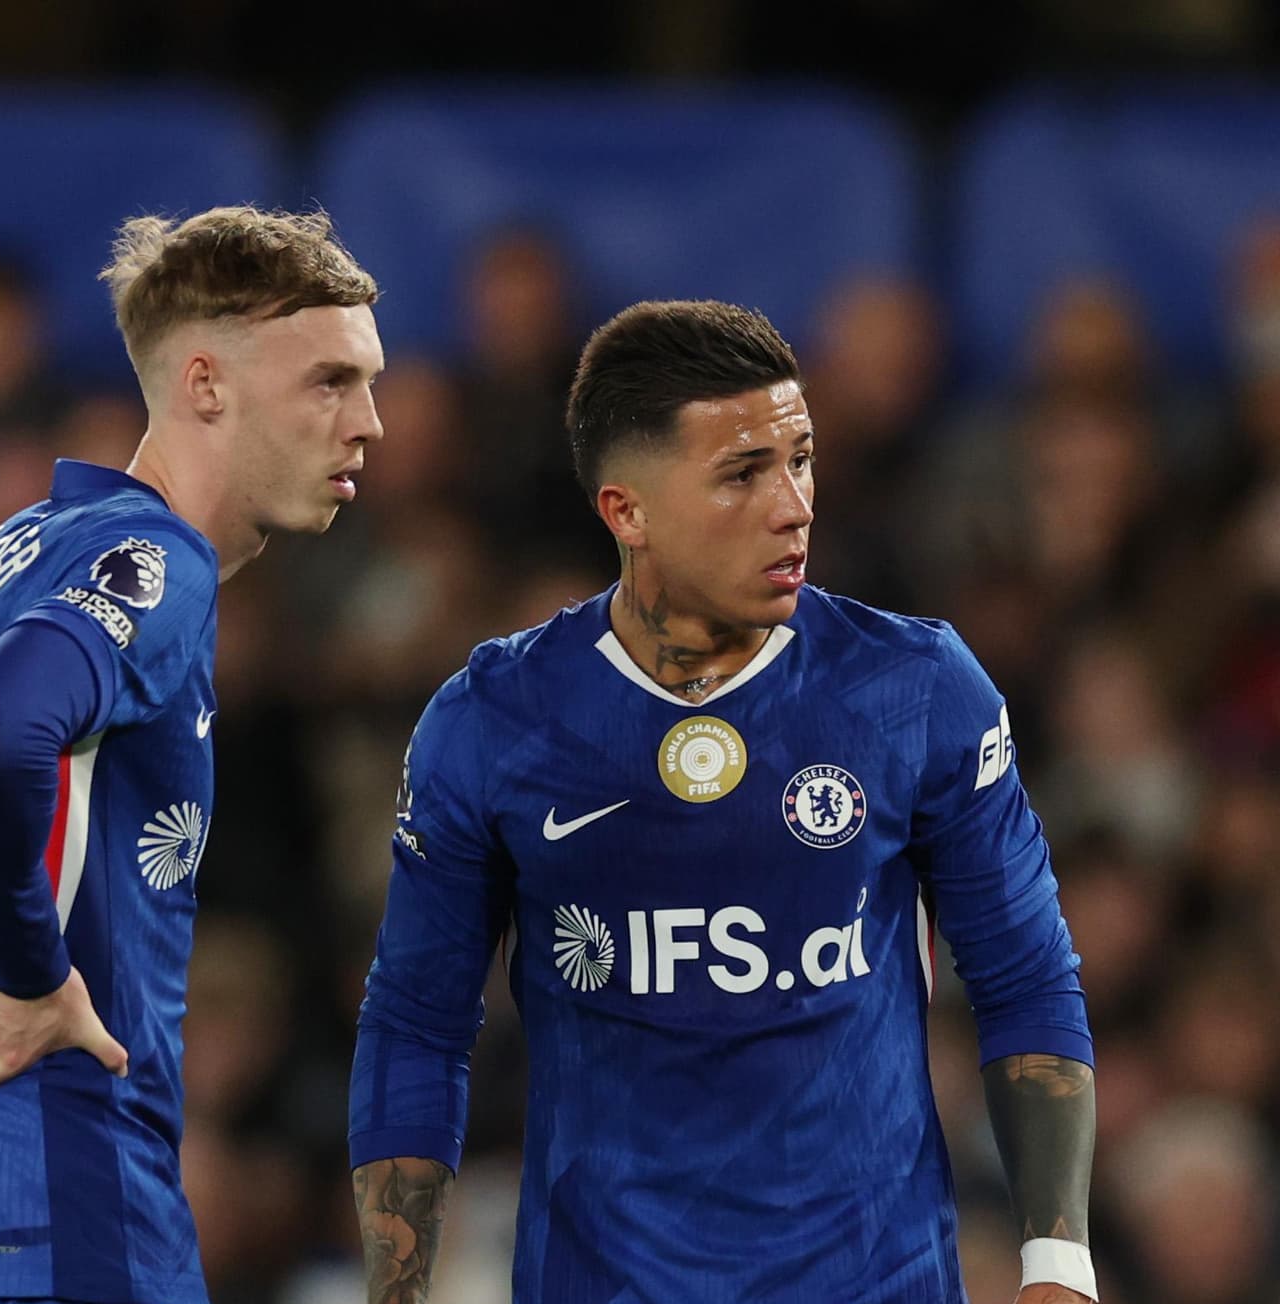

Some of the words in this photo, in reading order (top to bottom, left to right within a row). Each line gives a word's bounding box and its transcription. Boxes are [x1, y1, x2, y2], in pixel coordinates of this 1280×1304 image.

[78, 602, 129, 650] racism
[87, 593, 133, 636] room
[666, 732, 686, 773] WORLD
[687, 723, 739, 766] CHAMPIONS
[688, 781, 721, 796] FIFA
[794, 767, 848, 787] CHELSEA
[627, 886, 871, 995] IFS.ai
